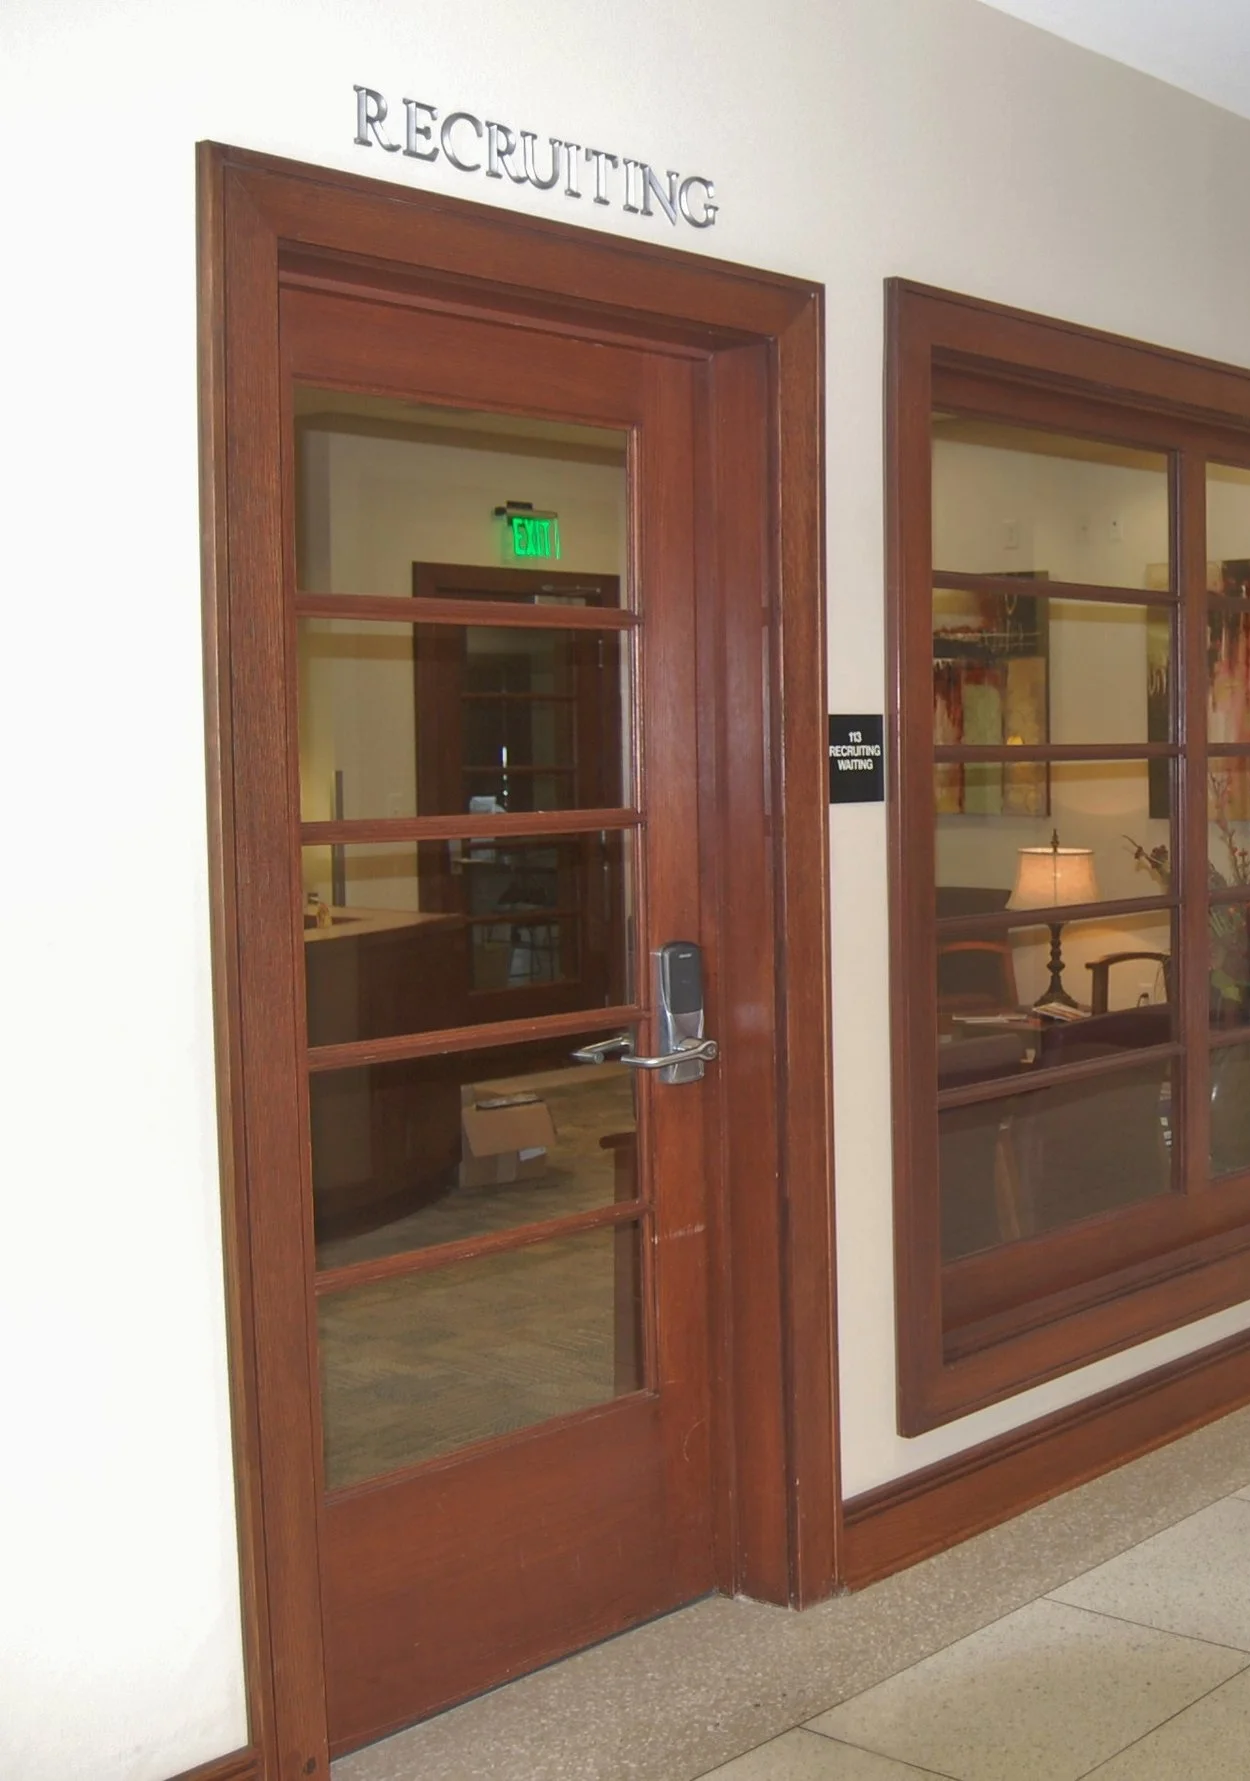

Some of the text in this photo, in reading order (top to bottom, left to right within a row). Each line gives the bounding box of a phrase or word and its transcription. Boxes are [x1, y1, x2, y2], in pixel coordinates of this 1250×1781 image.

[353, 84, 719, 229] RECRUITING
[512, 518, 550, 557] EXIT
[848, 731, 862, 743] 113
[829, 745, 881, 757] RECRUITING
[837, 759, 874, 771] WAITING
